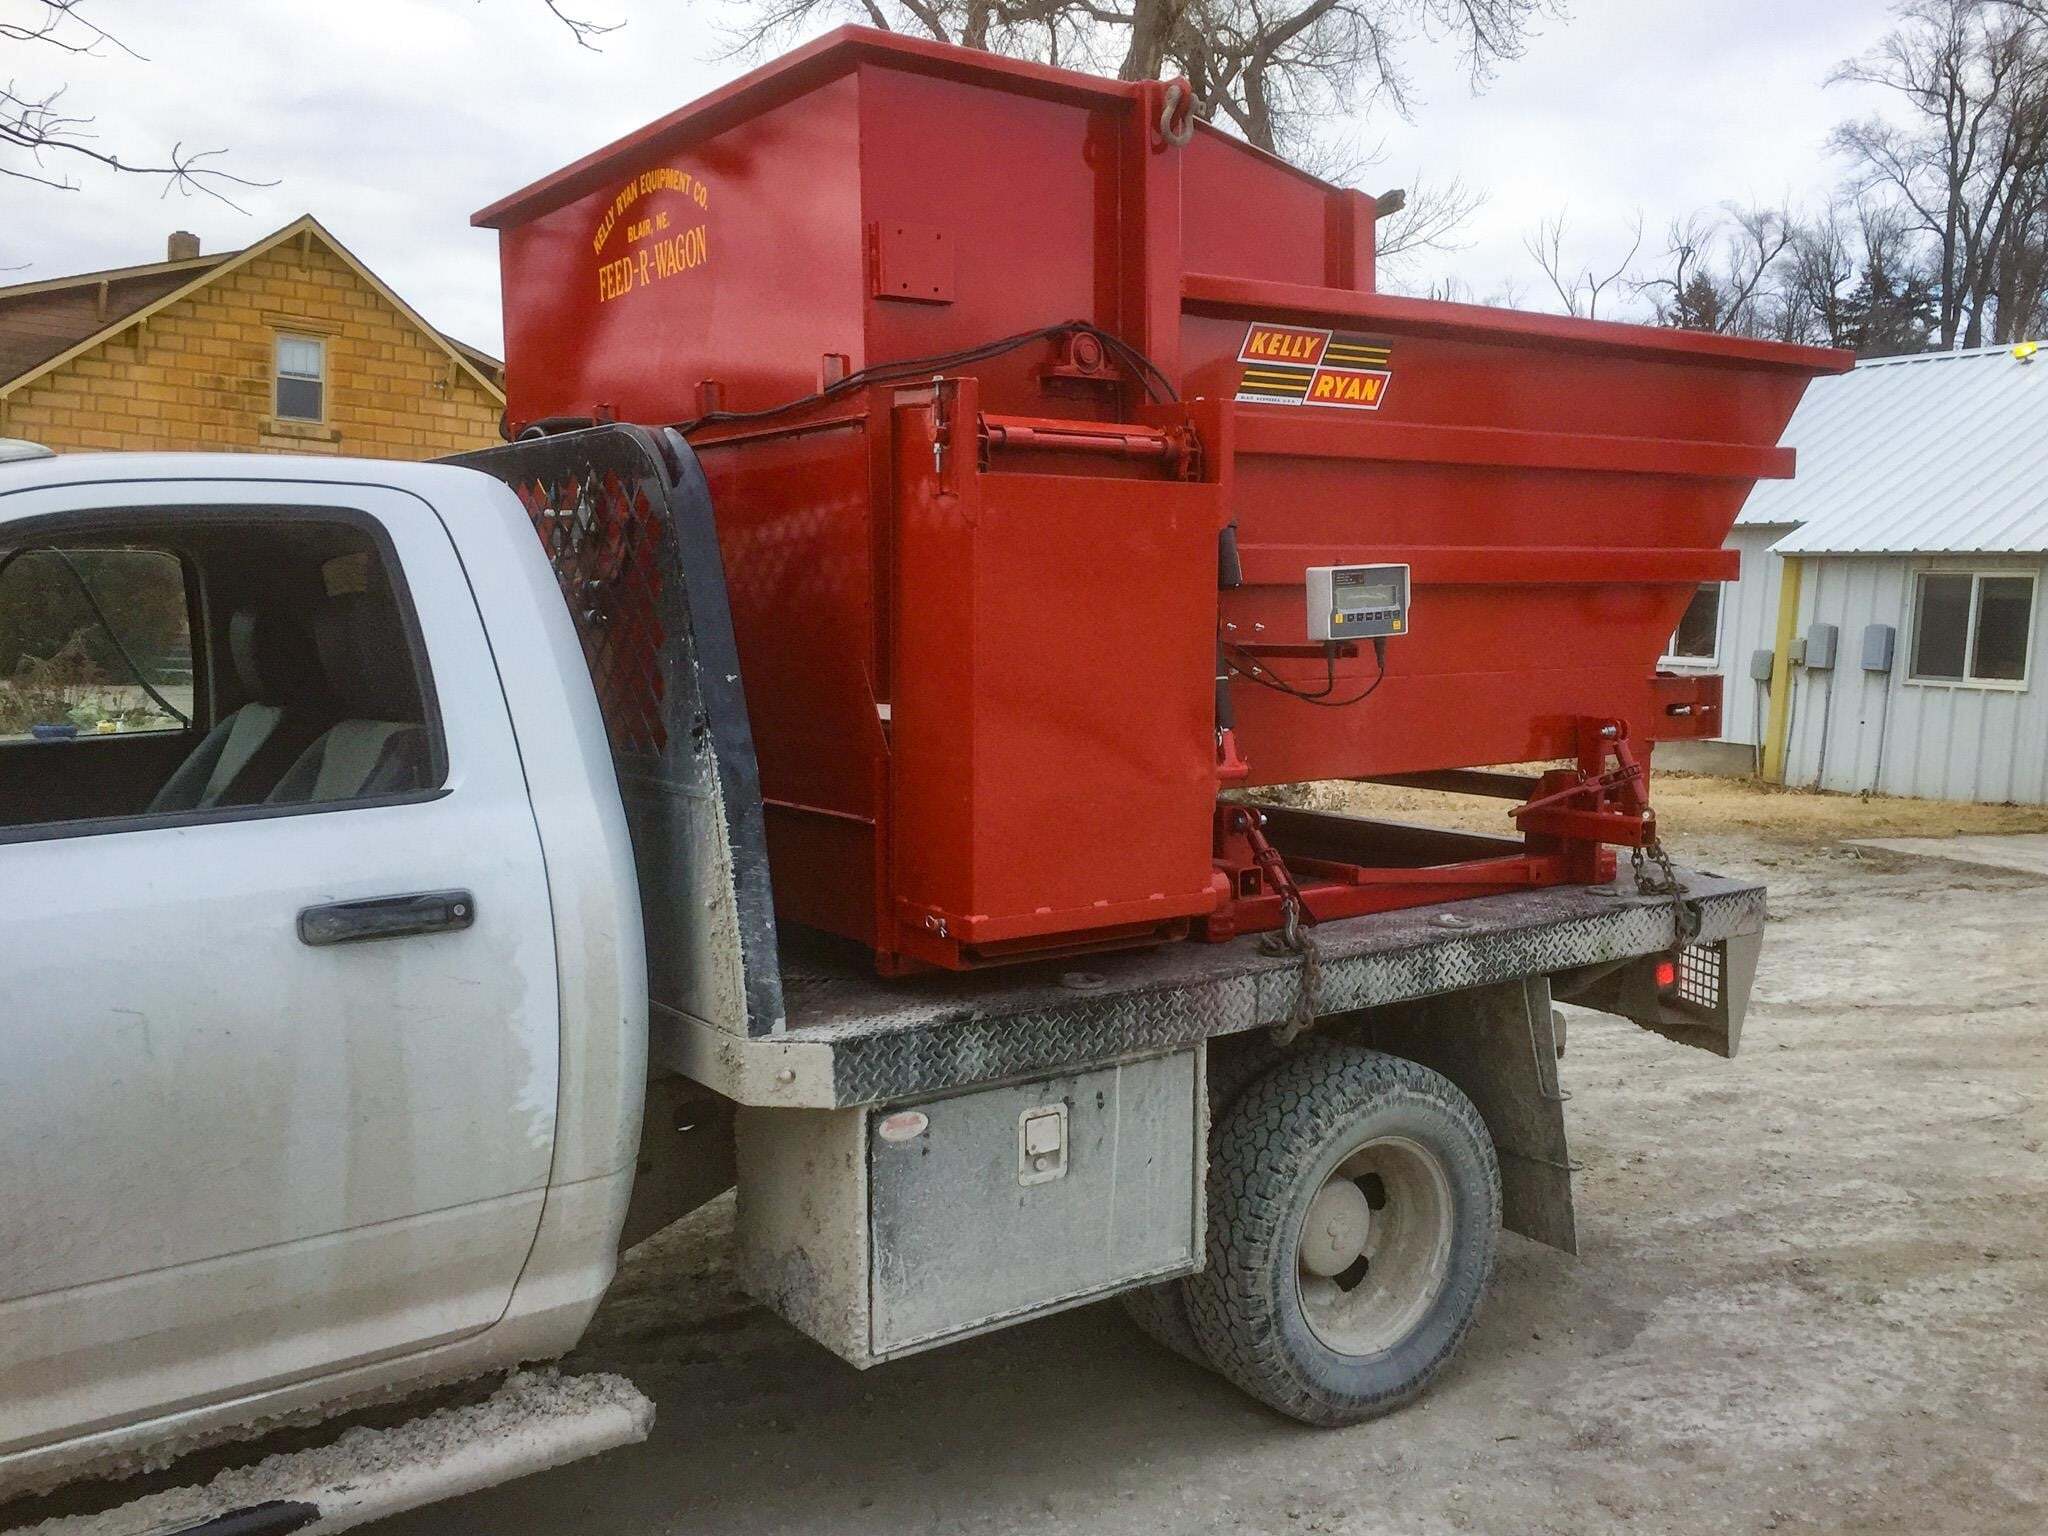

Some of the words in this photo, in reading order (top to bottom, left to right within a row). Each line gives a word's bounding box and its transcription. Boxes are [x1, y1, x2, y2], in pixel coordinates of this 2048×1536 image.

[593, 206, 615, 255] KELLY
[616, 180, 638, 216] RYAN
[640, 168, 692, 195] EQUIPMENT
[694, 181, 708, 211] CO.
[627, 219, 653, 243] BLAIR,
[656, 212, 670, 231] NE.
[599, 224, 707, 302] FEED-R-WAGON
[1250, 331, 1320, 358] KELLY
[1314, 374, 1380, 400] RYAN
